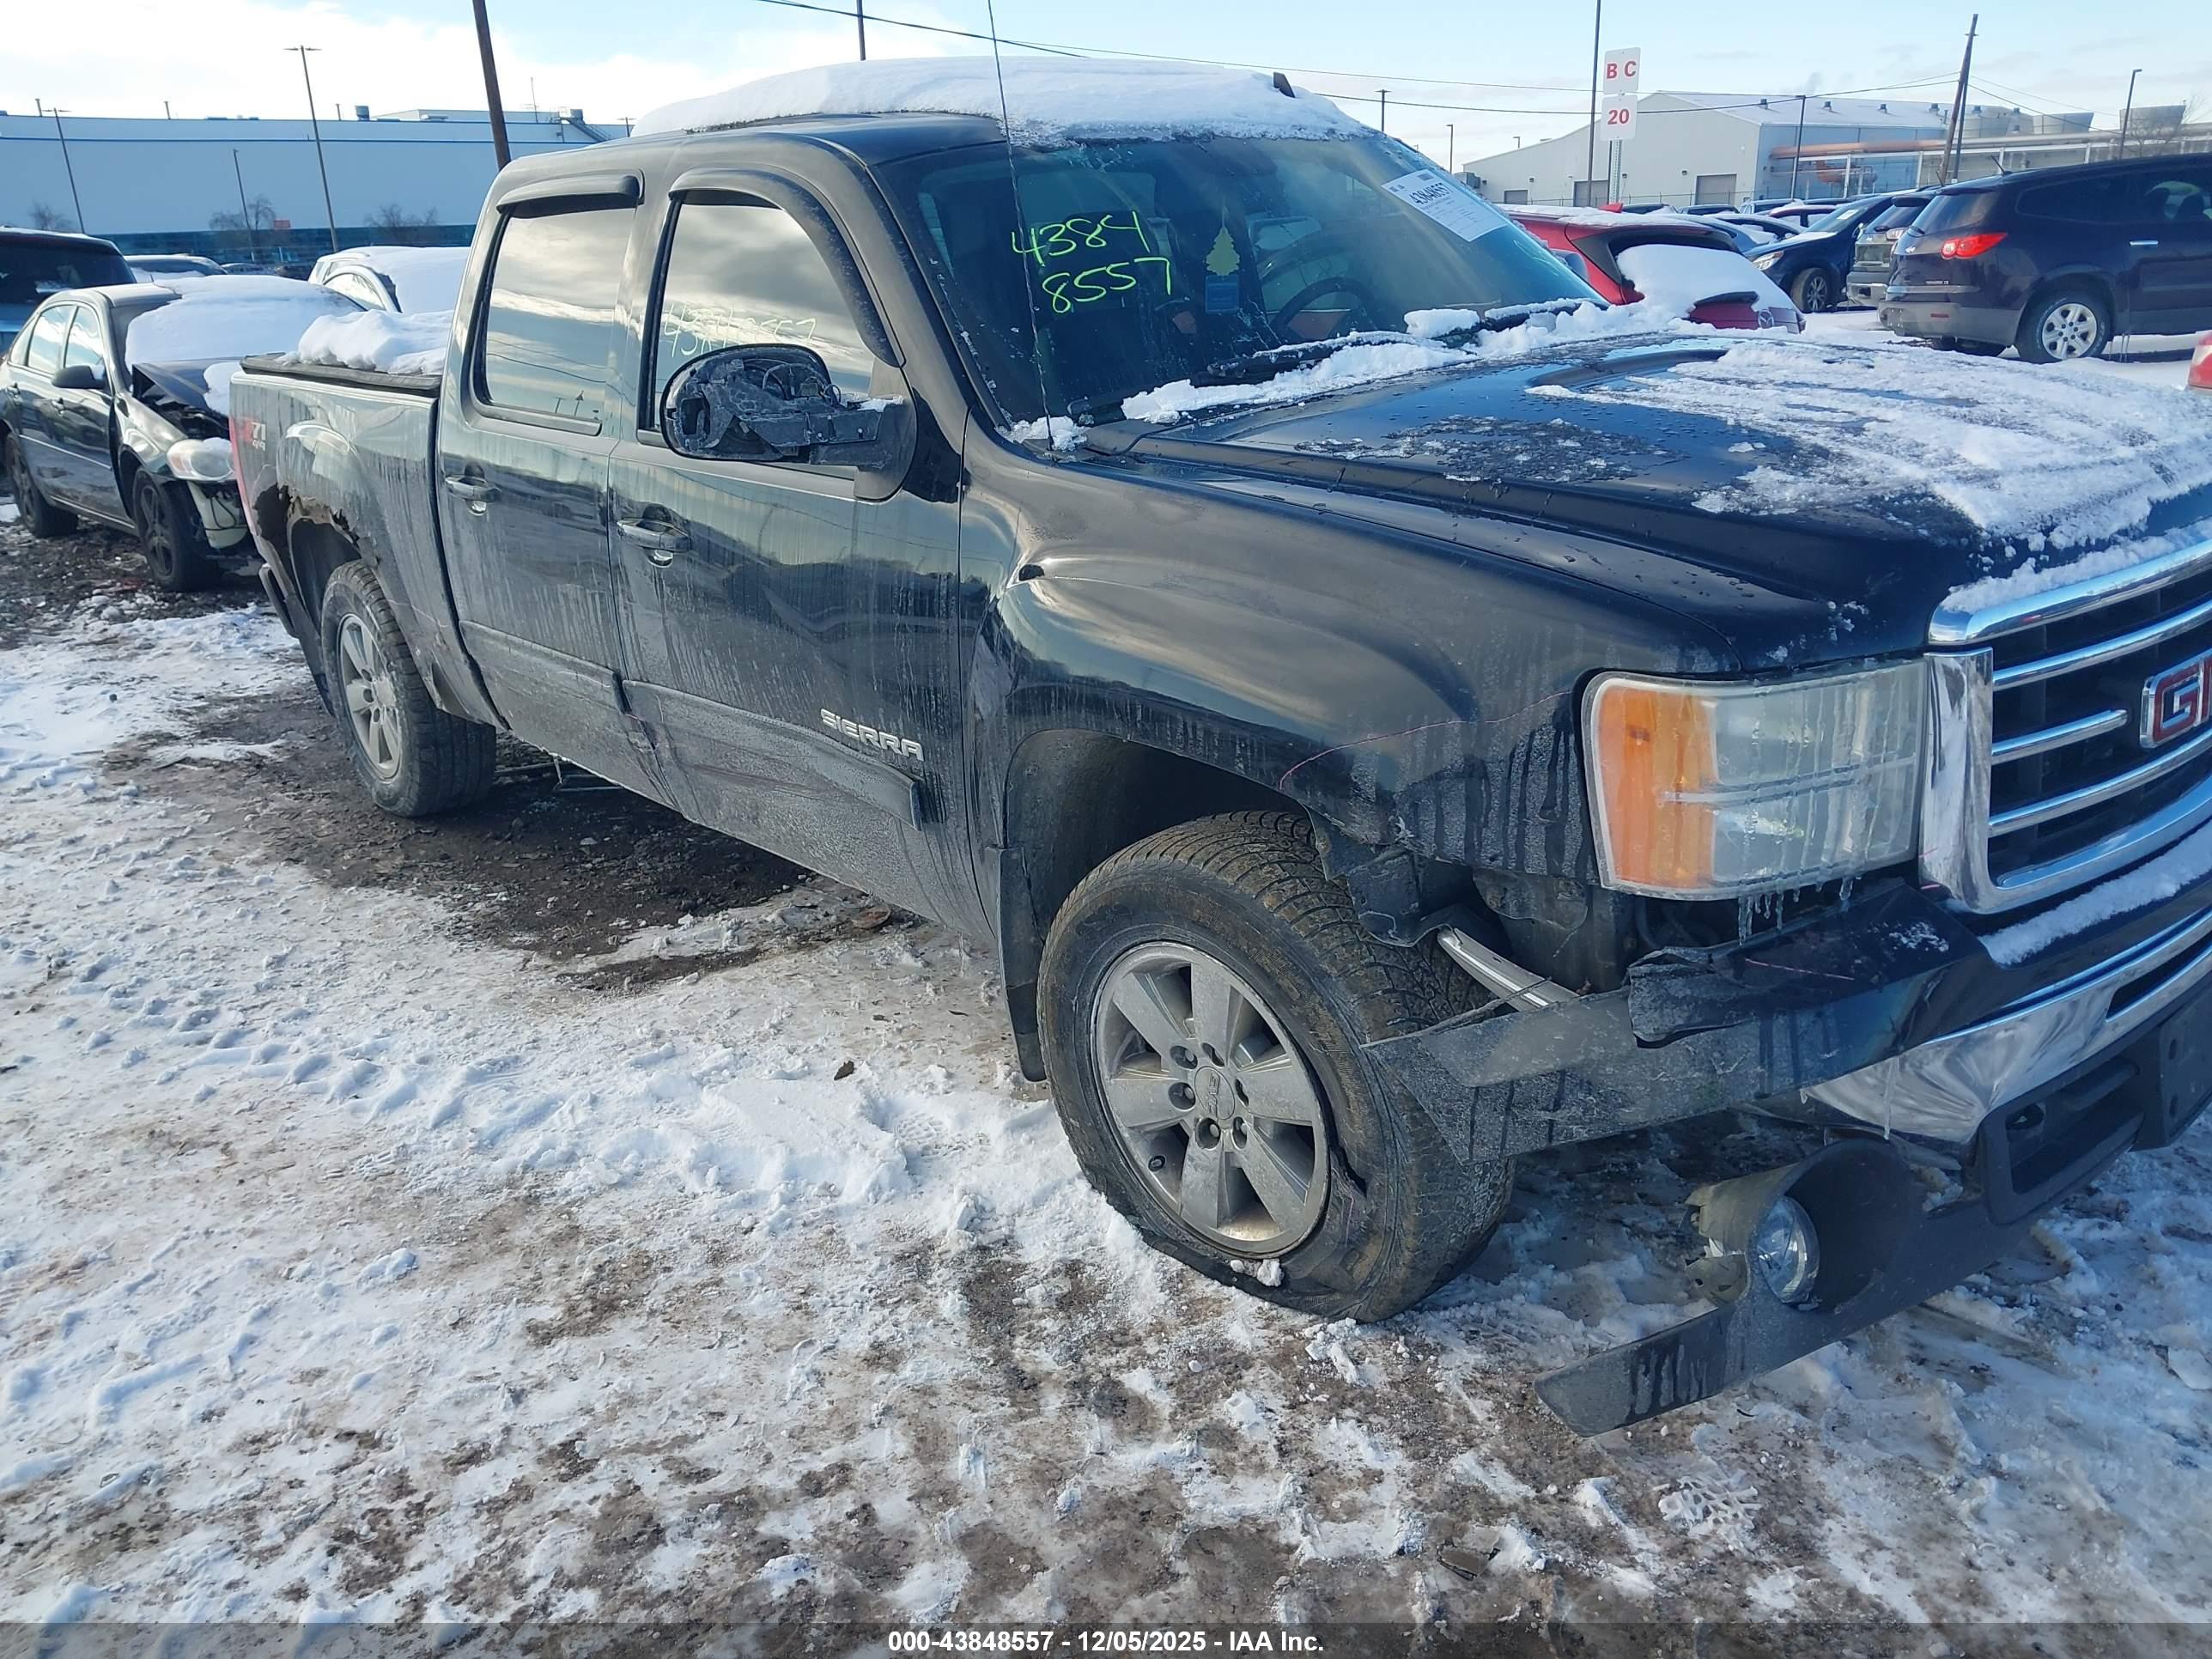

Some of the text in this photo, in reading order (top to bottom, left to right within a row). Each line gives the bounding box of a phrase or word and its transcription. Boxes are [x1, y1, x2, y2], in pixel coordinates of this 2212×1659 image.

[1606, 60, 1637, 79] B C
[1607, 108, 1630, 125] 20
[1012, 210, 1151, 267] 4384
[1042, 256, 1171, 313] 8557
[2139, 647, 2212, 749] G
[820, 708, 925, 763] SIERRA
